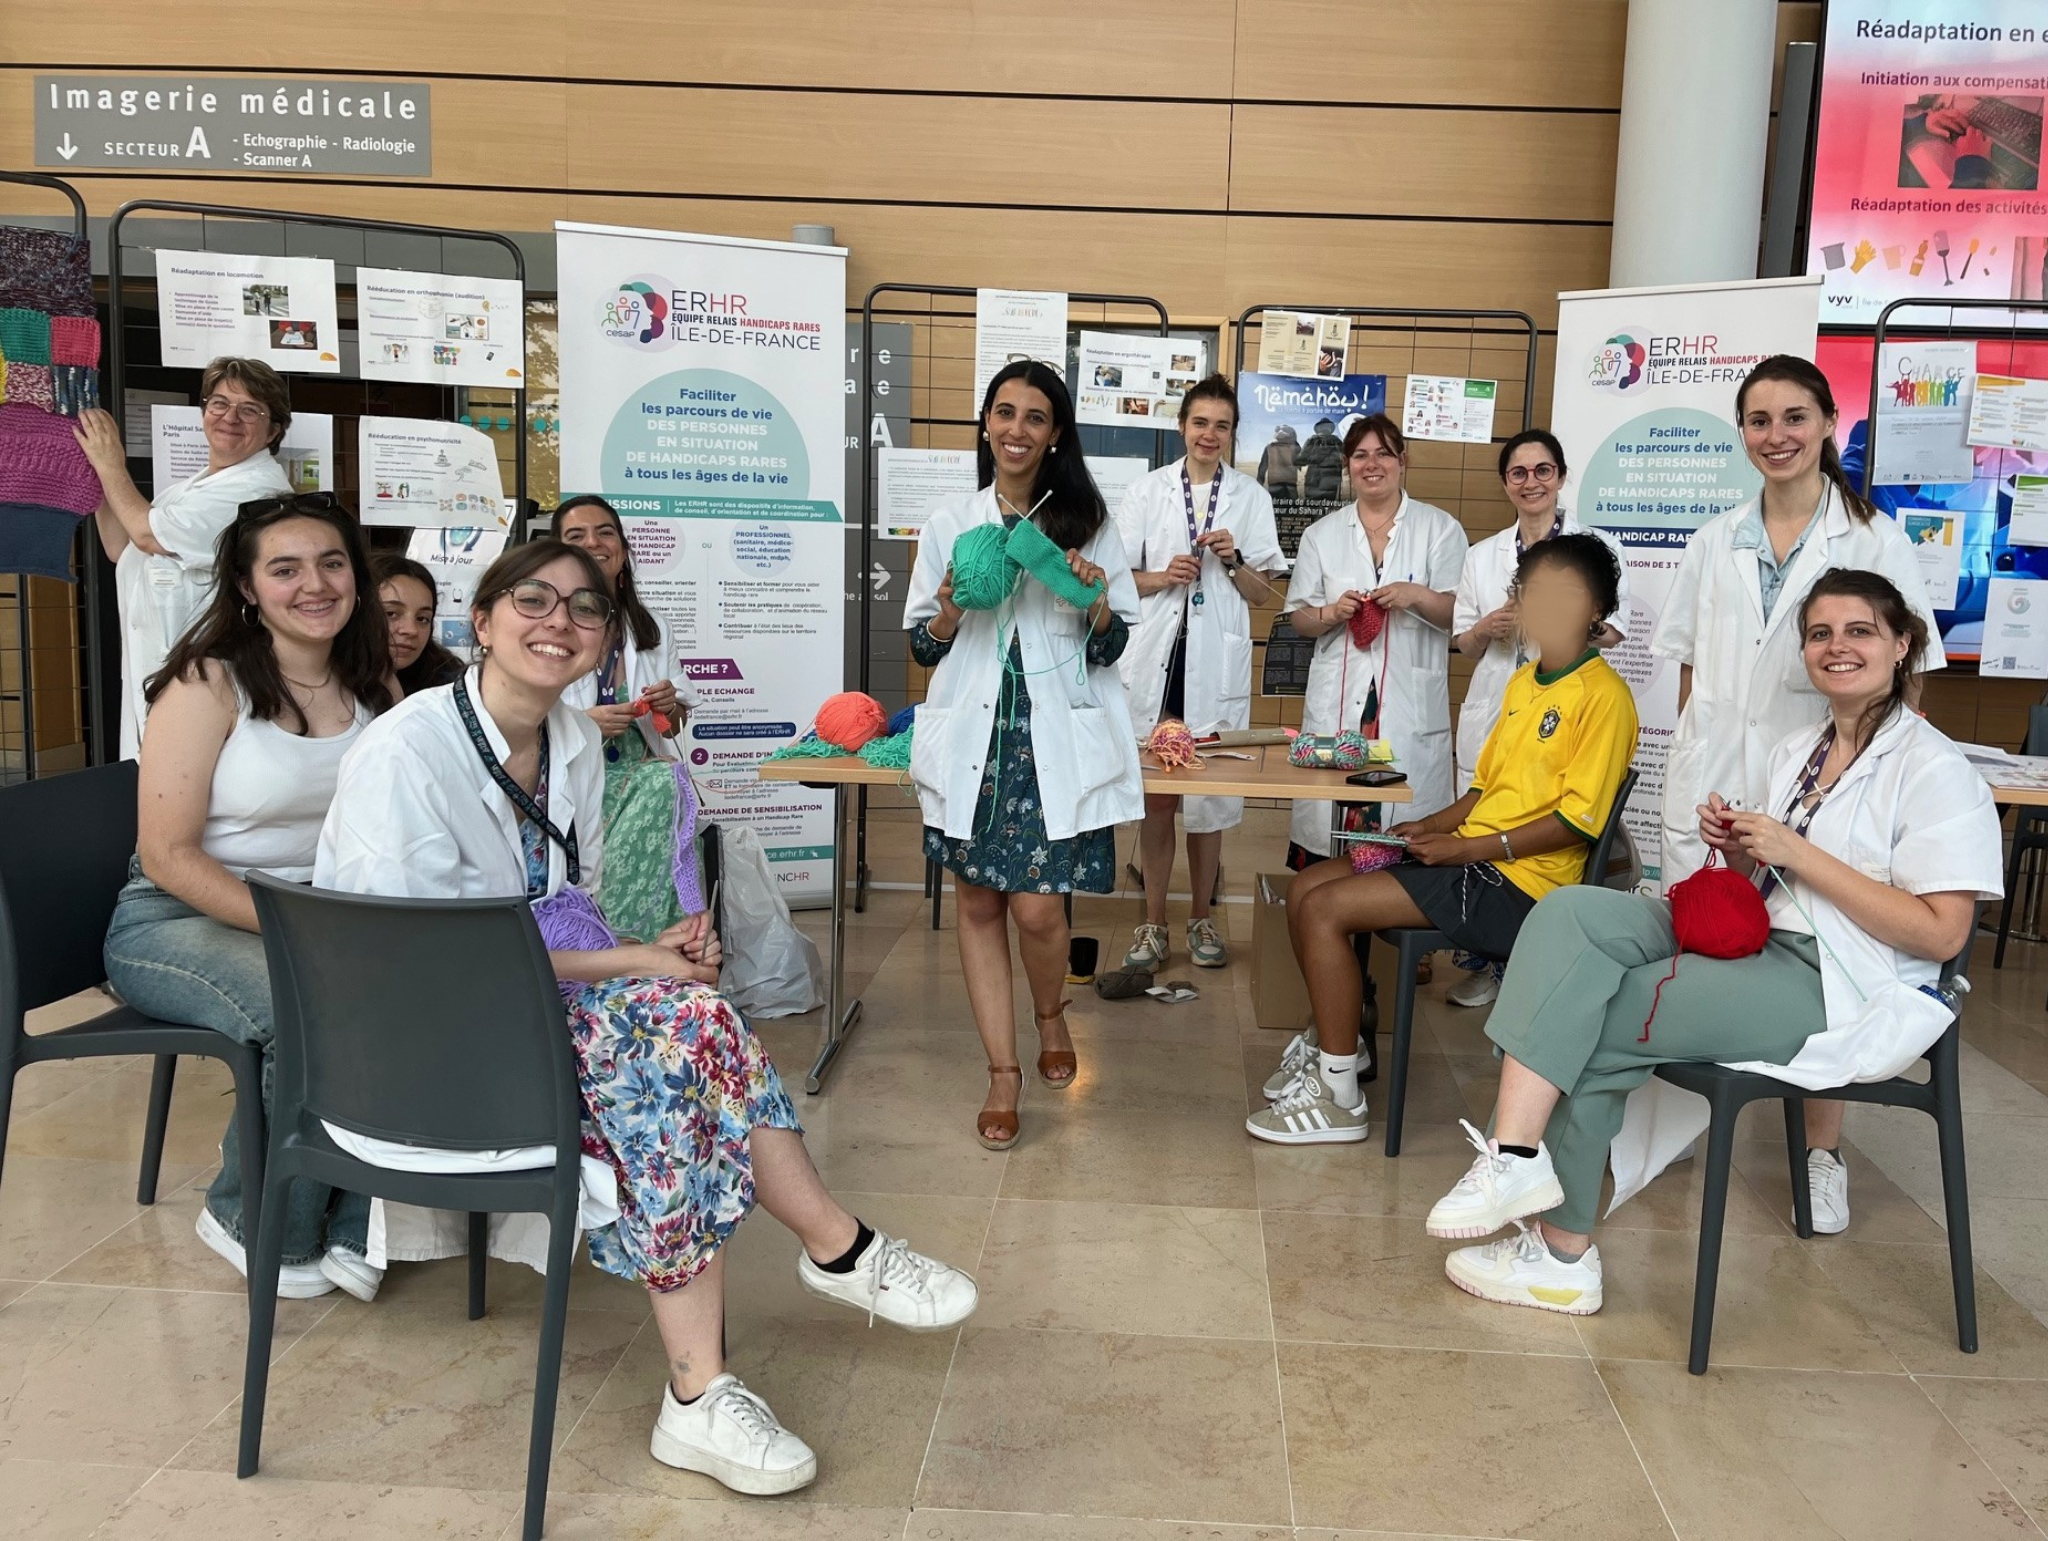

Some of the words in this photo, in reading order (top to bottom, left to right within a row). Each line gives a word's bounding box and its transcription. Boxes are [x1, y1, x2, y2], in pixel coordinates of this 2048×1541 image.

[1857, 19, 2001, 43] Réadaptation
[2010, 28, 2034, 42] en
[1861, 72, 1929, 85] Initiation
[1933, 75, 1960, 86] aux
[50, 83, 217, 116] Imagerie
[240, 87, 416, 120] médicale
[104, 142, 180, 157] SECTEUR
[185, 125, 211, 159] A
[244, 134, 327, 150] Echographie
[343, 137, 415, 154] Radiologie
[244, 152, 297, 166] Scanner
[302, 154, 312, 167] A
[1851, 197, 1951, 214] Réadaptation
[1956, 200, 1981, 213] des
[1986, 200, 2047, 215] activités
[171, 268, 215, 277] Réadaptation
[367, 285, 405, 294] Rééducation
[671, 289, 747, 316] ERHR
[1828, 295, 1852, 306] vyv
[671, 311, 704, 324] ÉQUIPE
[706, 315, 737, 326] RELAIS
[740, 317, 791, 330] HANDICAPS
[793, 322, 821, 333] RARES
[671, 323, 821, 351] ÎLE-DE-FRANCE
[1650, 335, 1718, 356] ERHR
[1649, 357, 1676, 368] ÉQUIPE
[1679, 356, 1707, 366] RELAIS
[1710, 355, 1758, 365] HANDICAPS
[680, 388, 736, 402] Faciliter
[642, 403, 661, 414] les
[666, 406, 727, 417] parcours
[731, 408, 748, 419] de
[753, 409, 772, 419] vie
[163, 424, 193, 432] L'Hôpital
[647, 420, 676, 431] DES
[681, 421, 767, 435] PERSONNES
[871, 413, 893, 447] A
[1650, 427, 1700, 437] Faciliter
[657, 436, 677, 447] EN
[681, 437, 758, 451] SITUATION
[1615, 443, 1632, 452] les
[1636, 443, 1690, 454] parcours
[1694, 442, 1710, 452] de
[1714, 442, 1733, 452] vie
[627, 451, 646, 462] DE
[650, 452, 736, 466] HANDICAPS
[740, 457, 787, 468] RARES
[1619, 458, 1644, 468] DES
[1648, 458, 1726, 468] PERSONNES
[625, 467, 633, 478] à
[638, 468, 668, 479] tous
[672, 469, 691, 480] les
[695, 469, 728, 483] âges
[732, 471, 749, 482] de
[753, 472, 764, 483] la
[769, 473, 788, 484] vie
[1626, 473, 1643, 482] EN
[1647, 473, 1717, 483] SITUATION
[1599, 488, 1616, 497] DE
[1619, 488, 1695, 498] HANDICAPS
[1699, 488, 1744, 499] RARES
[1596, 501, 1603, 511] à
[1607, 502, 1633, 512] tous
[1637, 502, 1653, 512] les
[1656, 502, 1686, 514] âges
[1690, 504, 1705, 514] de
[1710, 504, 1720, 514] la
[874, 592, 888, 600] sol
[698, 807, 739, 816] DEMANDE
[754, 804, 822, 813] SENSIBILISATION
[775, 872, 809, 882] NCHR
